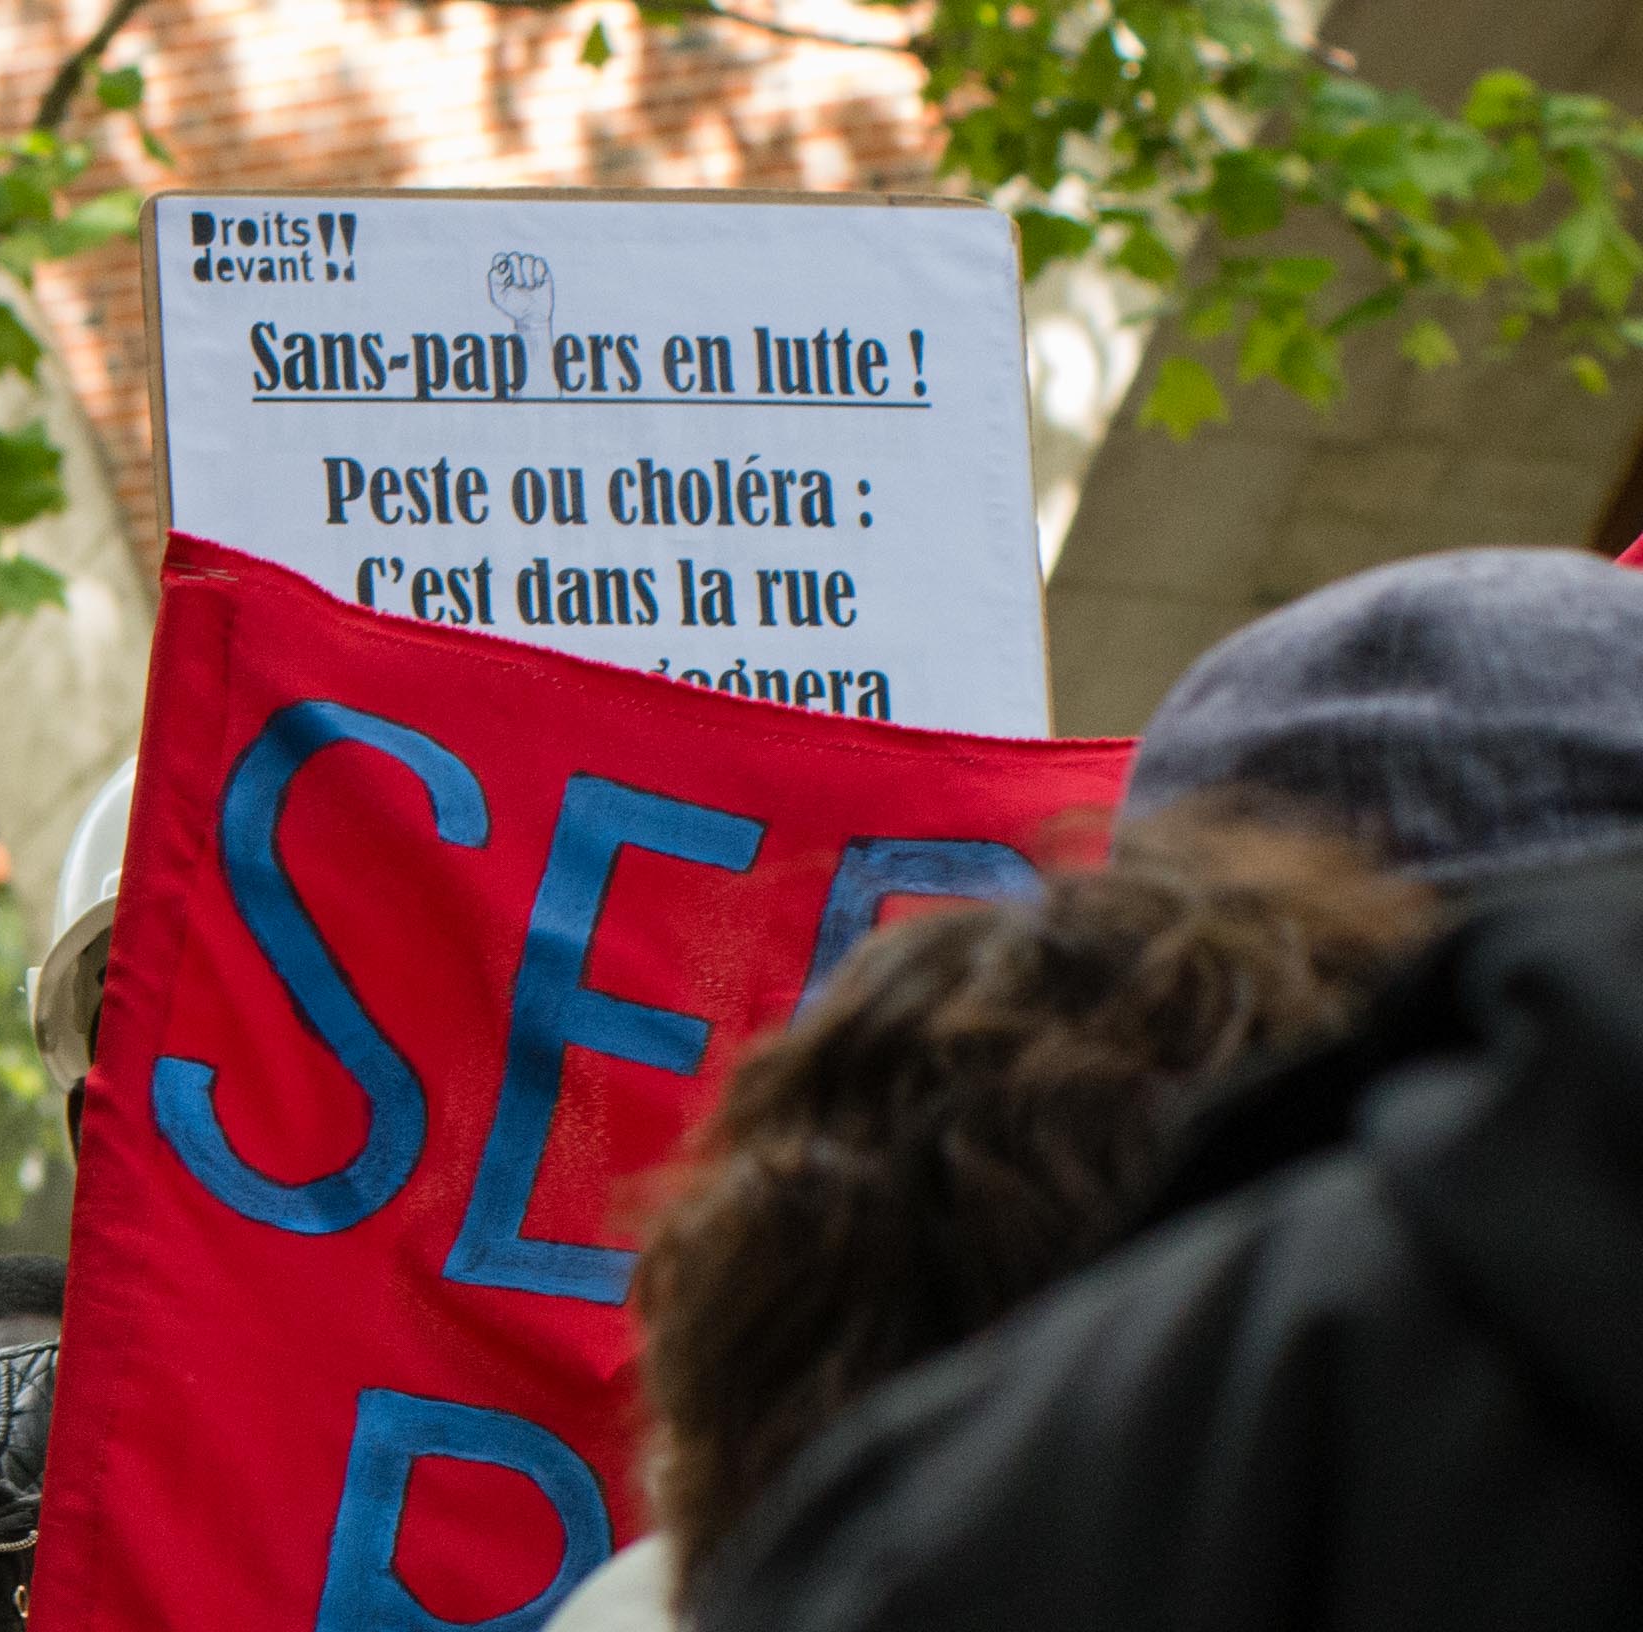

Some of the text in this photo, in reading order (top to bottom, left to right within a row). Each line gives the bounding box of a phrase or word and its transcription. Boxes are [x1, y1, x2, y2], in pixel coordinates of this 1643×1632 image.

[192, 211, 311, 247] Droits
[193, 247, 315, 283] devant
[663, 335, 736, 394] en
[753, 327, 889, 397] lutte
[323, 456, 489, 526] Peste
[512, 467, 588, 527] ou
[608, 455, 836, 528] choléra
[516, 557, 659, 626] dans
[677, 559, 737, 627] la
[756, 569, 857, 628] rue
[152, 700, 1050, 1307] SE
